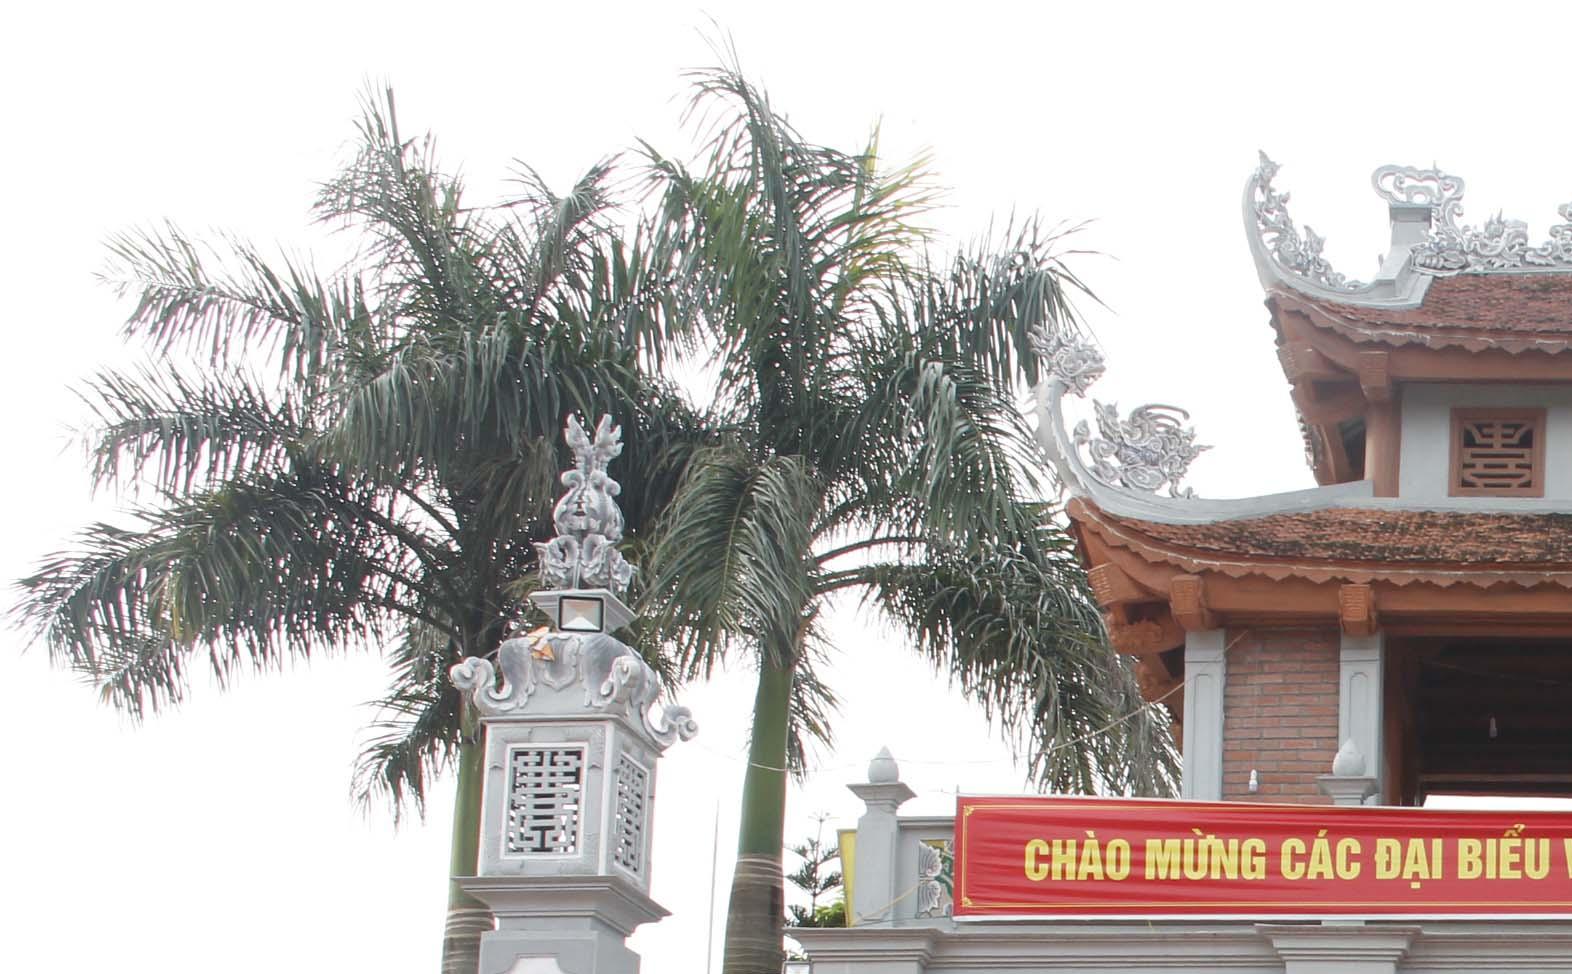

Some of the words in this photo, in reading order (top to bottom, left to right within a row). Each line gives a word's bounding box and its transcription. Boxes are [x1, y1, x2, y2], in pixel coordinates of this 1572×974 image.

[1024, 830, 1131, 881] CHÀO
[1145, 828, 1266, 880] MỪNG
[1280, 829, 1361, 880] CÁC
[1374, 838, 1443, 889] ĐẠI
[1458, 824, 1550, 880] BIỂU
